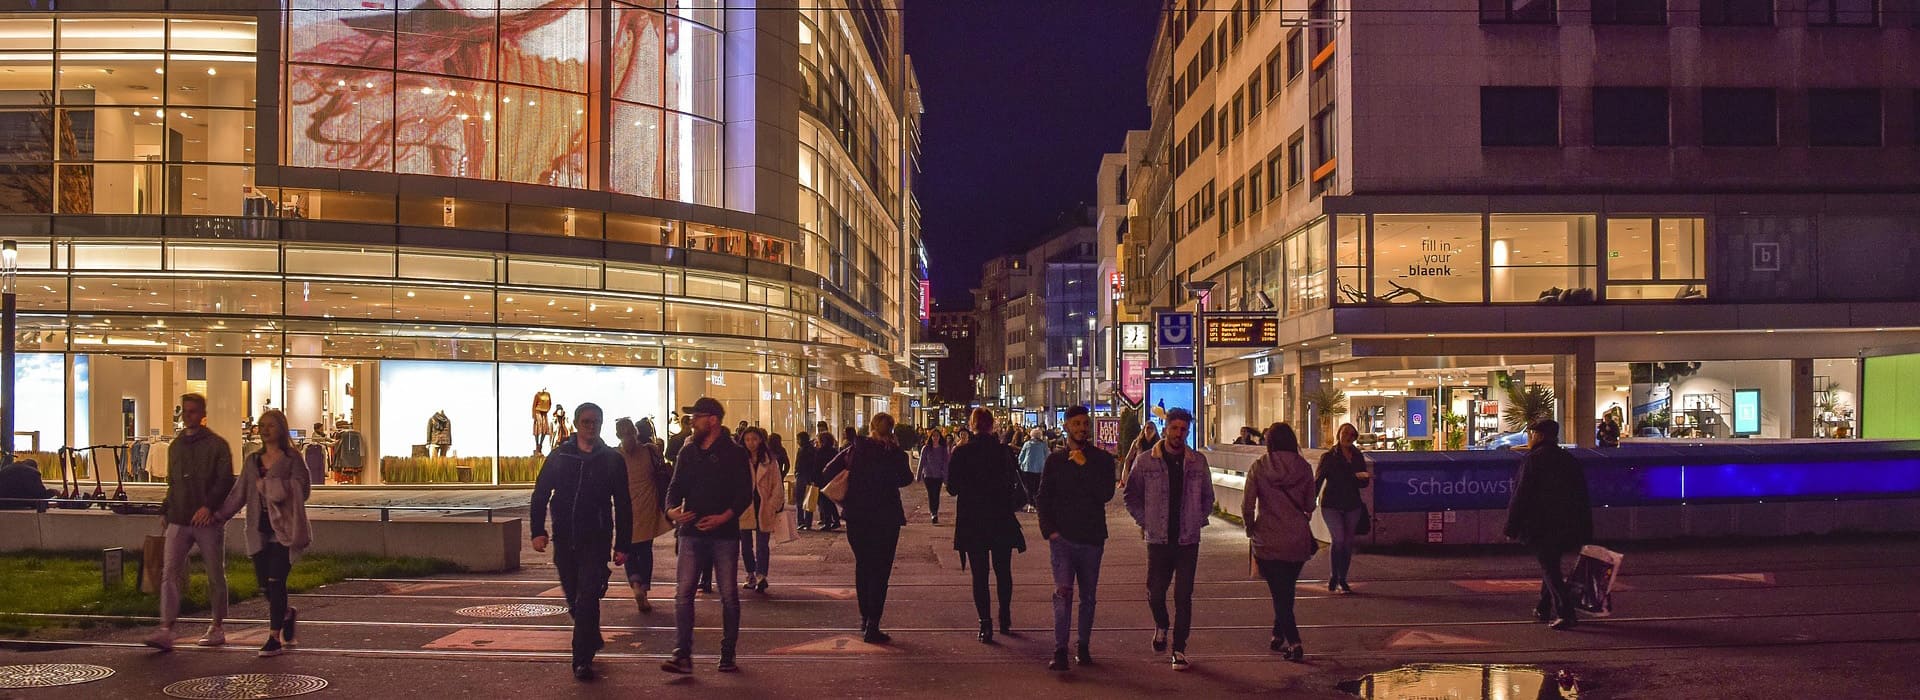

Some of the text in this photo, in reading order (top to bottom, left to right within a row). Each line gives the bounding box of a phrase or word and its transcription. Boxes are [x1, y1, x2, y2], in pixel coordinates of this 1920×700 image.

[1422, 240, 1451, 251] fill in
[1423, 254, 1451, 265] your
[1408, 476, 1515, 496] Schadowst
